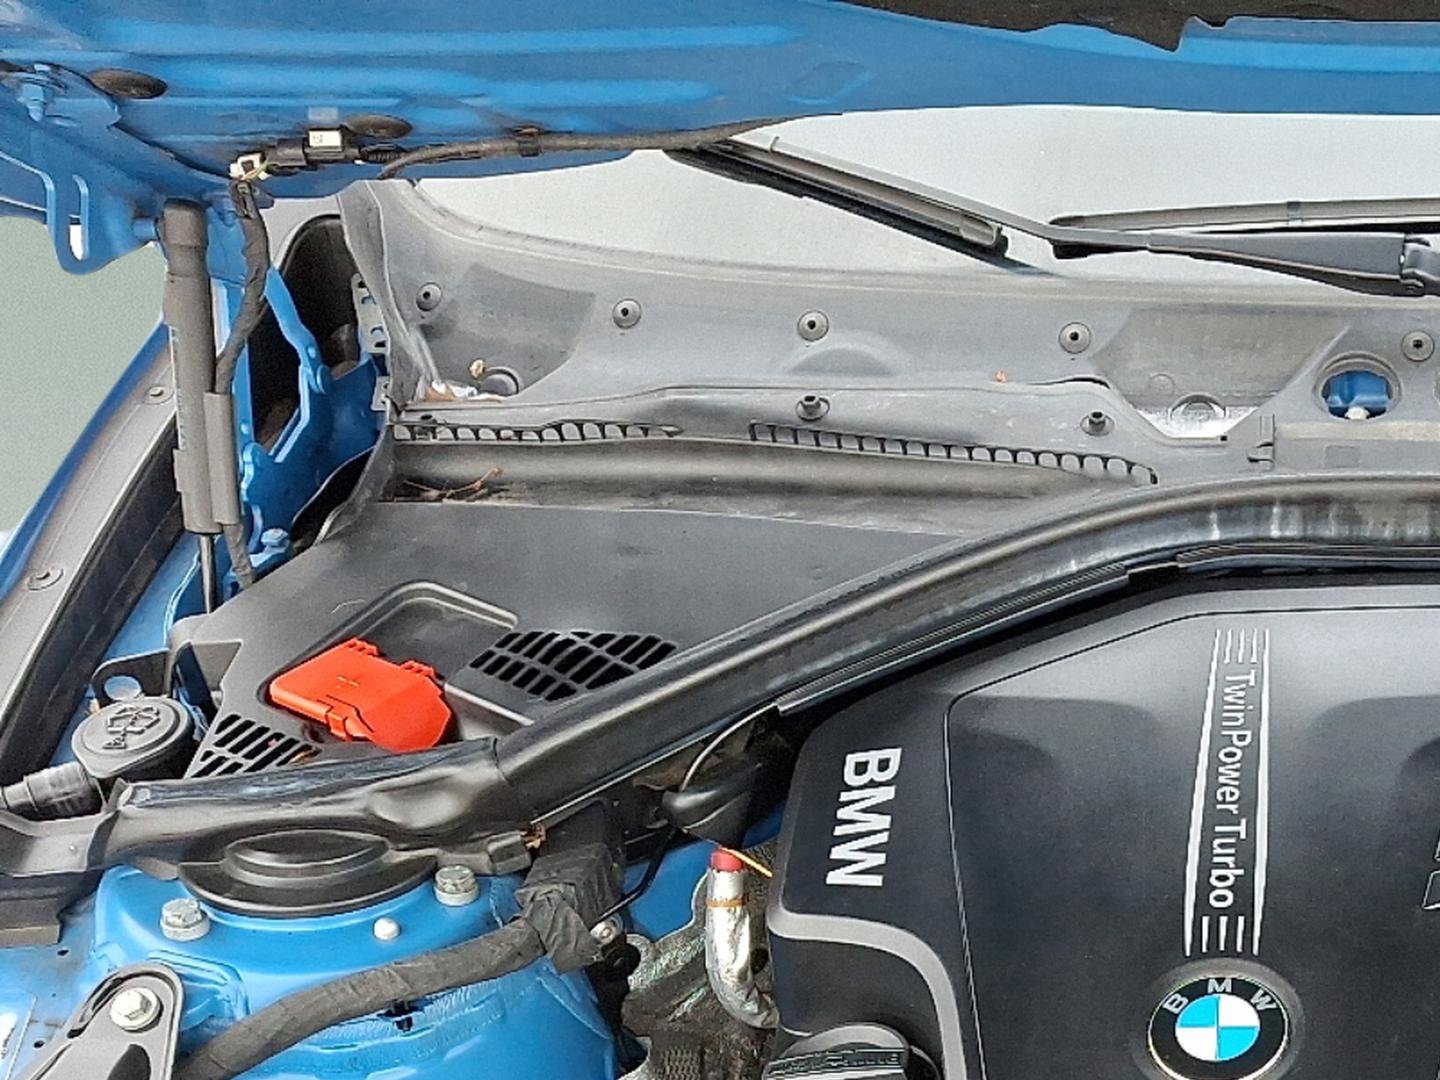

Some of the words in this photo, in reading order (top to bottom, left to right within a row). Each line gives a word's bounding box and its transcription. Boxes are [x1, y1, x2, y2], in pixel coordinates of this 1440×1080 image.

[826, 748, 902, 886] BMW
[1208, 818, 1248, 908] Turbo
[1163, 978, 1277, 1014] BMW
